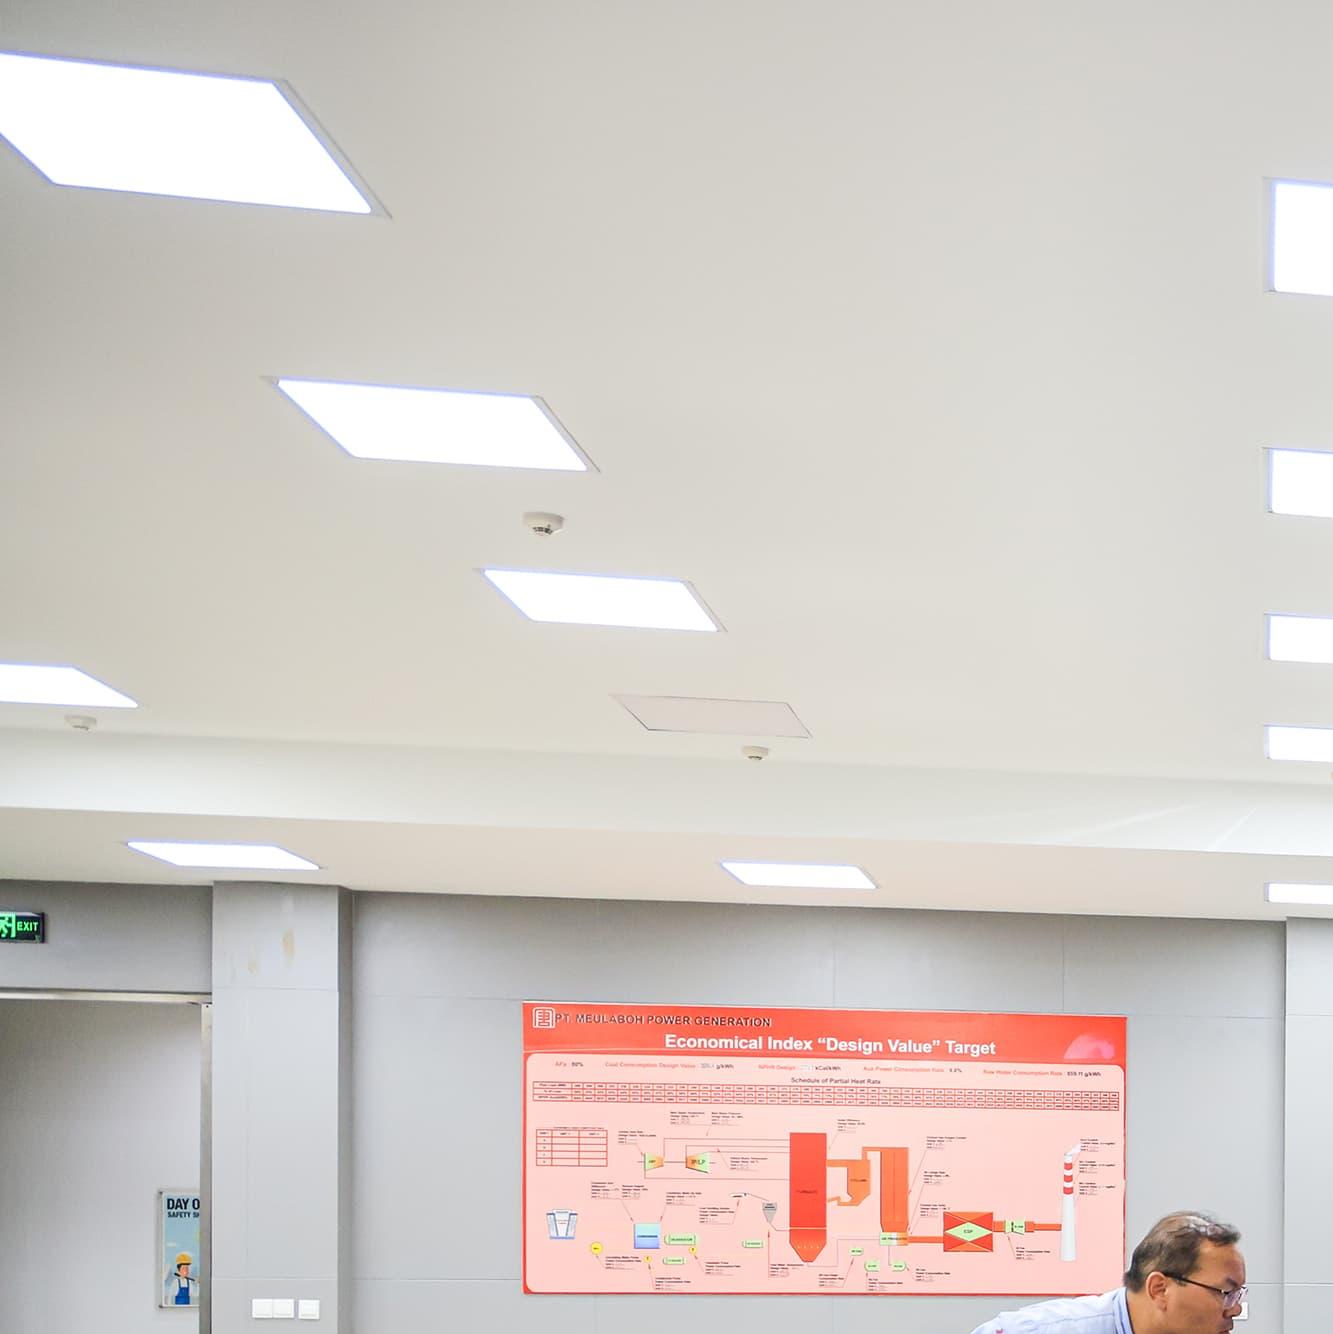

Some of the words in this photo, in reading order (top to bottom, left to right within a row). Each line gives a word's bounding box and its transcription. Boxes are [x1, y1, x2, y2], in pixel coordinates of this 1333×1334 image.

[17, 921, 39, 932] EXIT
[575, 1013, 644, 1025] MEULABOH
[647, 1015, 691, 1026] POWER
[696, 1016, 771, 1028] GENERATION
[664, 1033, 763, 1050] Economical
[767, 1035, 813, 1051] Index
[945, 1040, 996, 1058] Target
[167, 1198, 190, 1210] DAY
